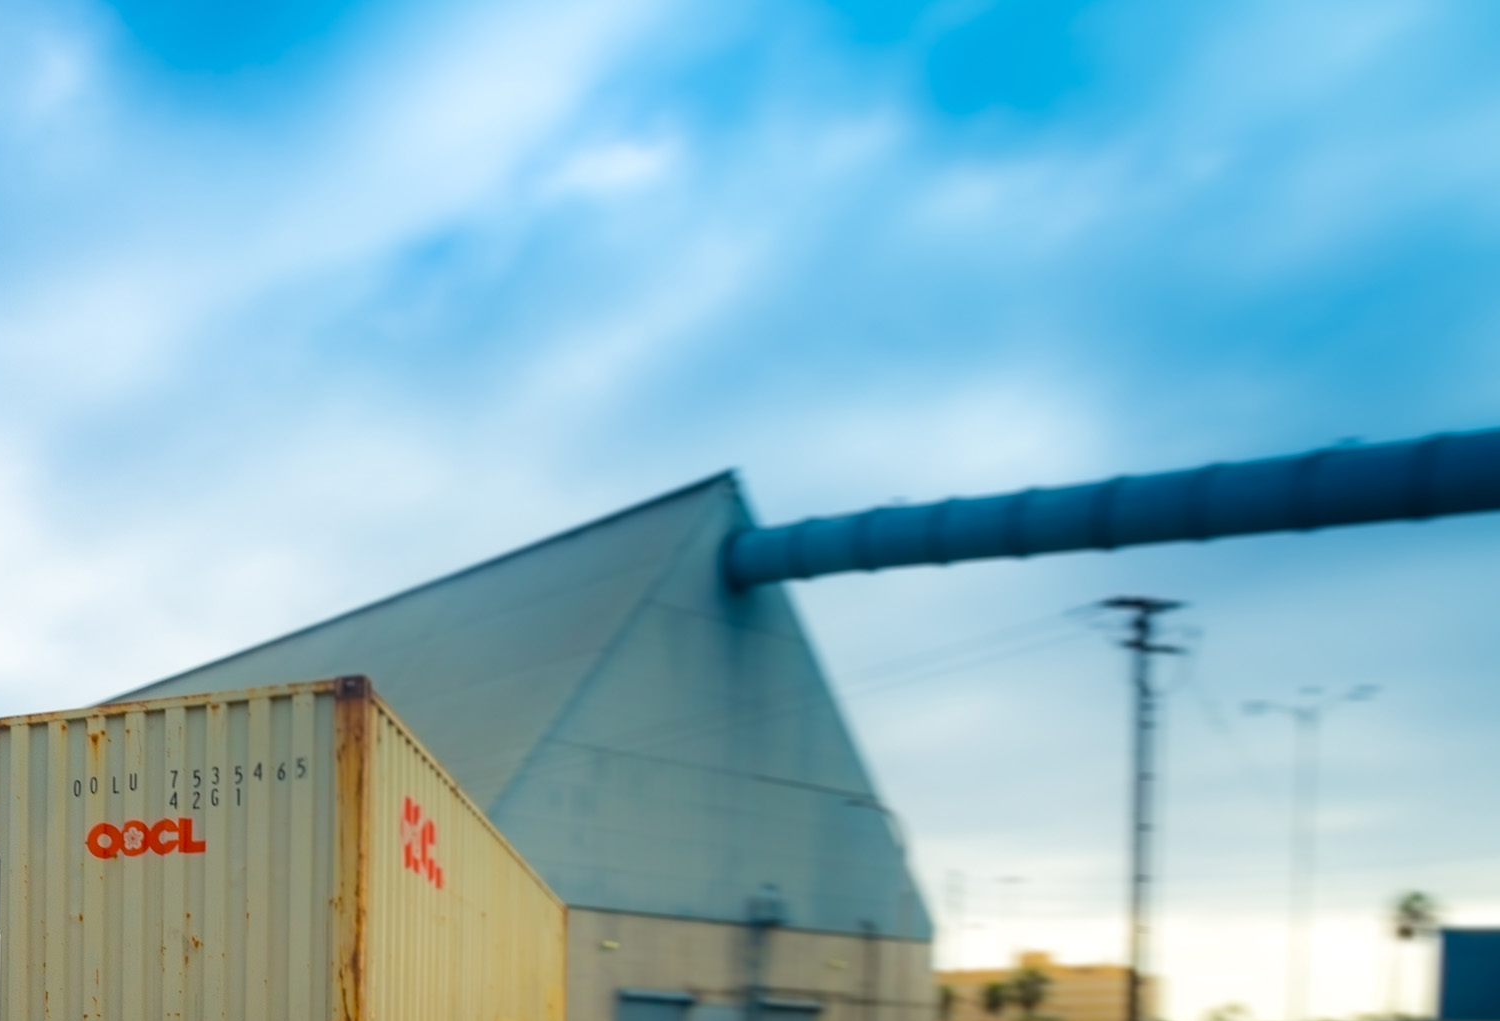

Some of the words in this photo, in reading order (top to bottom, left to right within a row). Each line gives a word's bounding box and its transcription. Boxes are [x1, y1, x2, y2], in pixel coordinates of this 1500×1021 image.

[169, 757, 307, 789] 7535465
[169, 788, 241, 810] 42G1
[86, 818, 206, 859] OOCL
